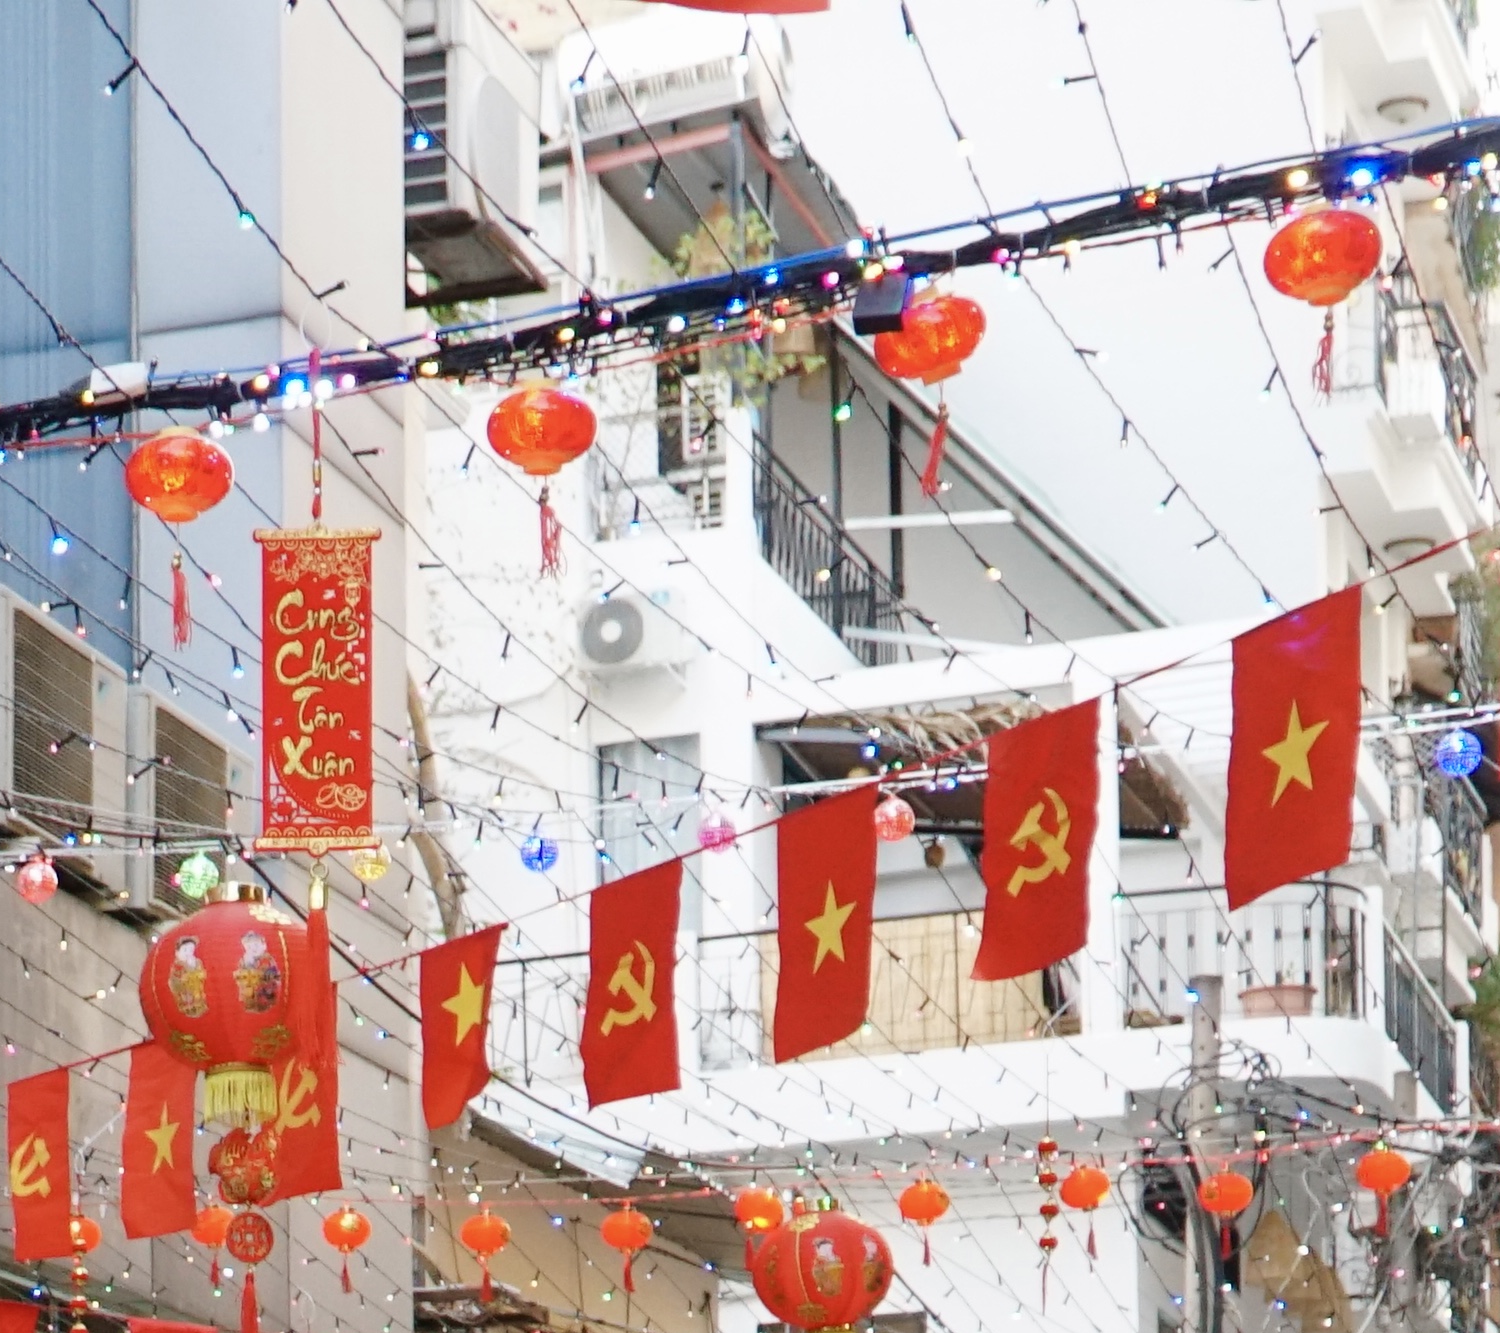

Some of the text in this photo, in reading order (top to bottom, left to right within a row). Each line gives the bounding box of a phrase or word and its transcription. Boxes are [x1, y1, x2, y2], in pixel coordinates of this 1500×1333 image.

[274, 638, 362, 687] Chúc
[291, 684, 345, 735] Tân
[280, 734, 357, 781] Xuân
